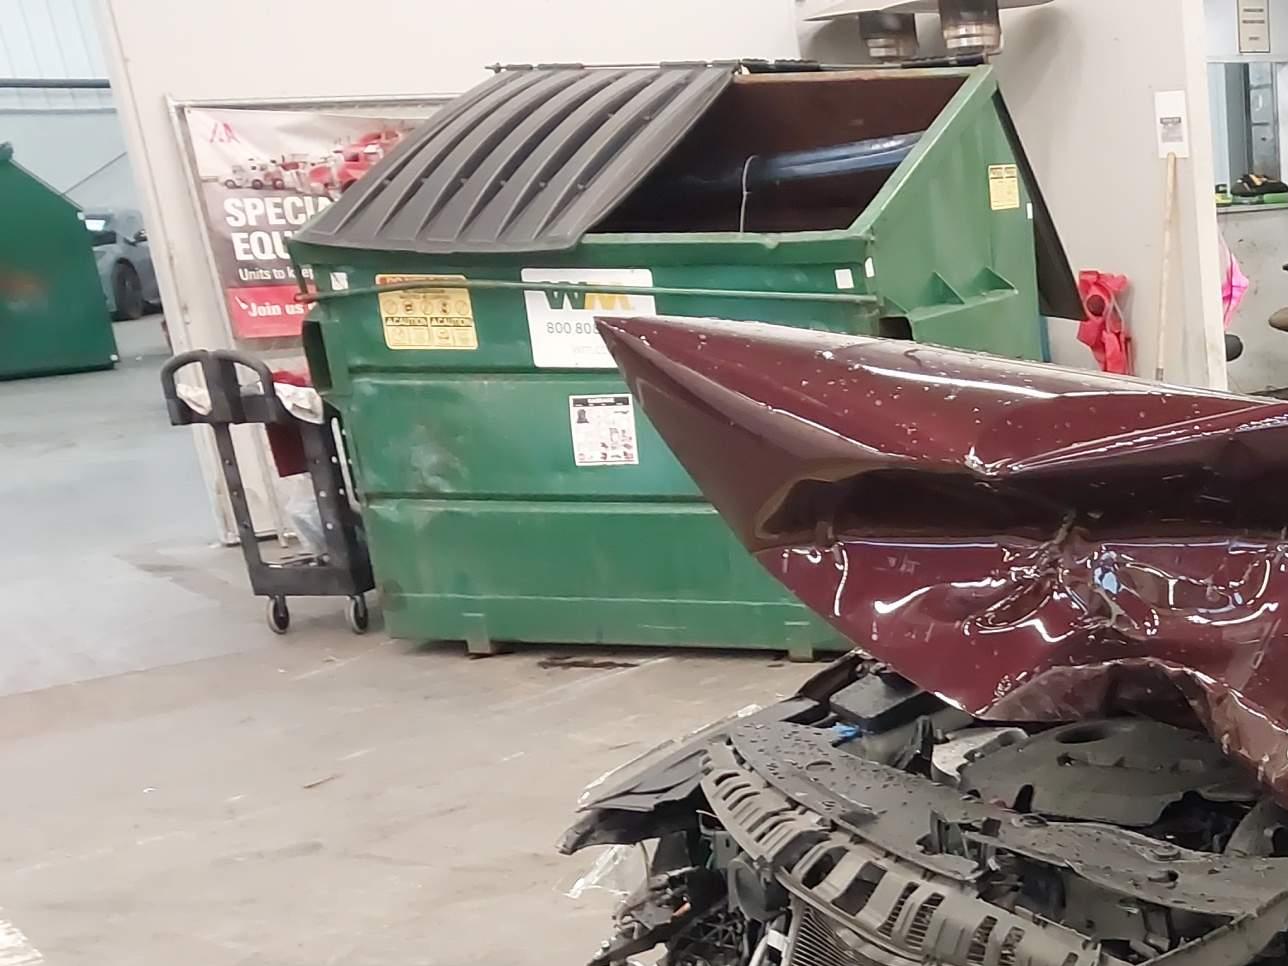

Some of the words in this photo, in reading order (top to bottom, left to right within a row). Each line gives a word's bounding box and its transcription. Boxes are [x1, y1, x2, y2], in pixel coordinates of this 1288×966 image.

[232, 230, 298, 261] EQU
[238, 266, 272, 281] Units
[272, 268, 286, 280] to
[541, 281, 635, 310] WM
[248, 301, 281, 317] Join
[284, 303, 304, 315] us
[546, 322, 572, 334] 800
